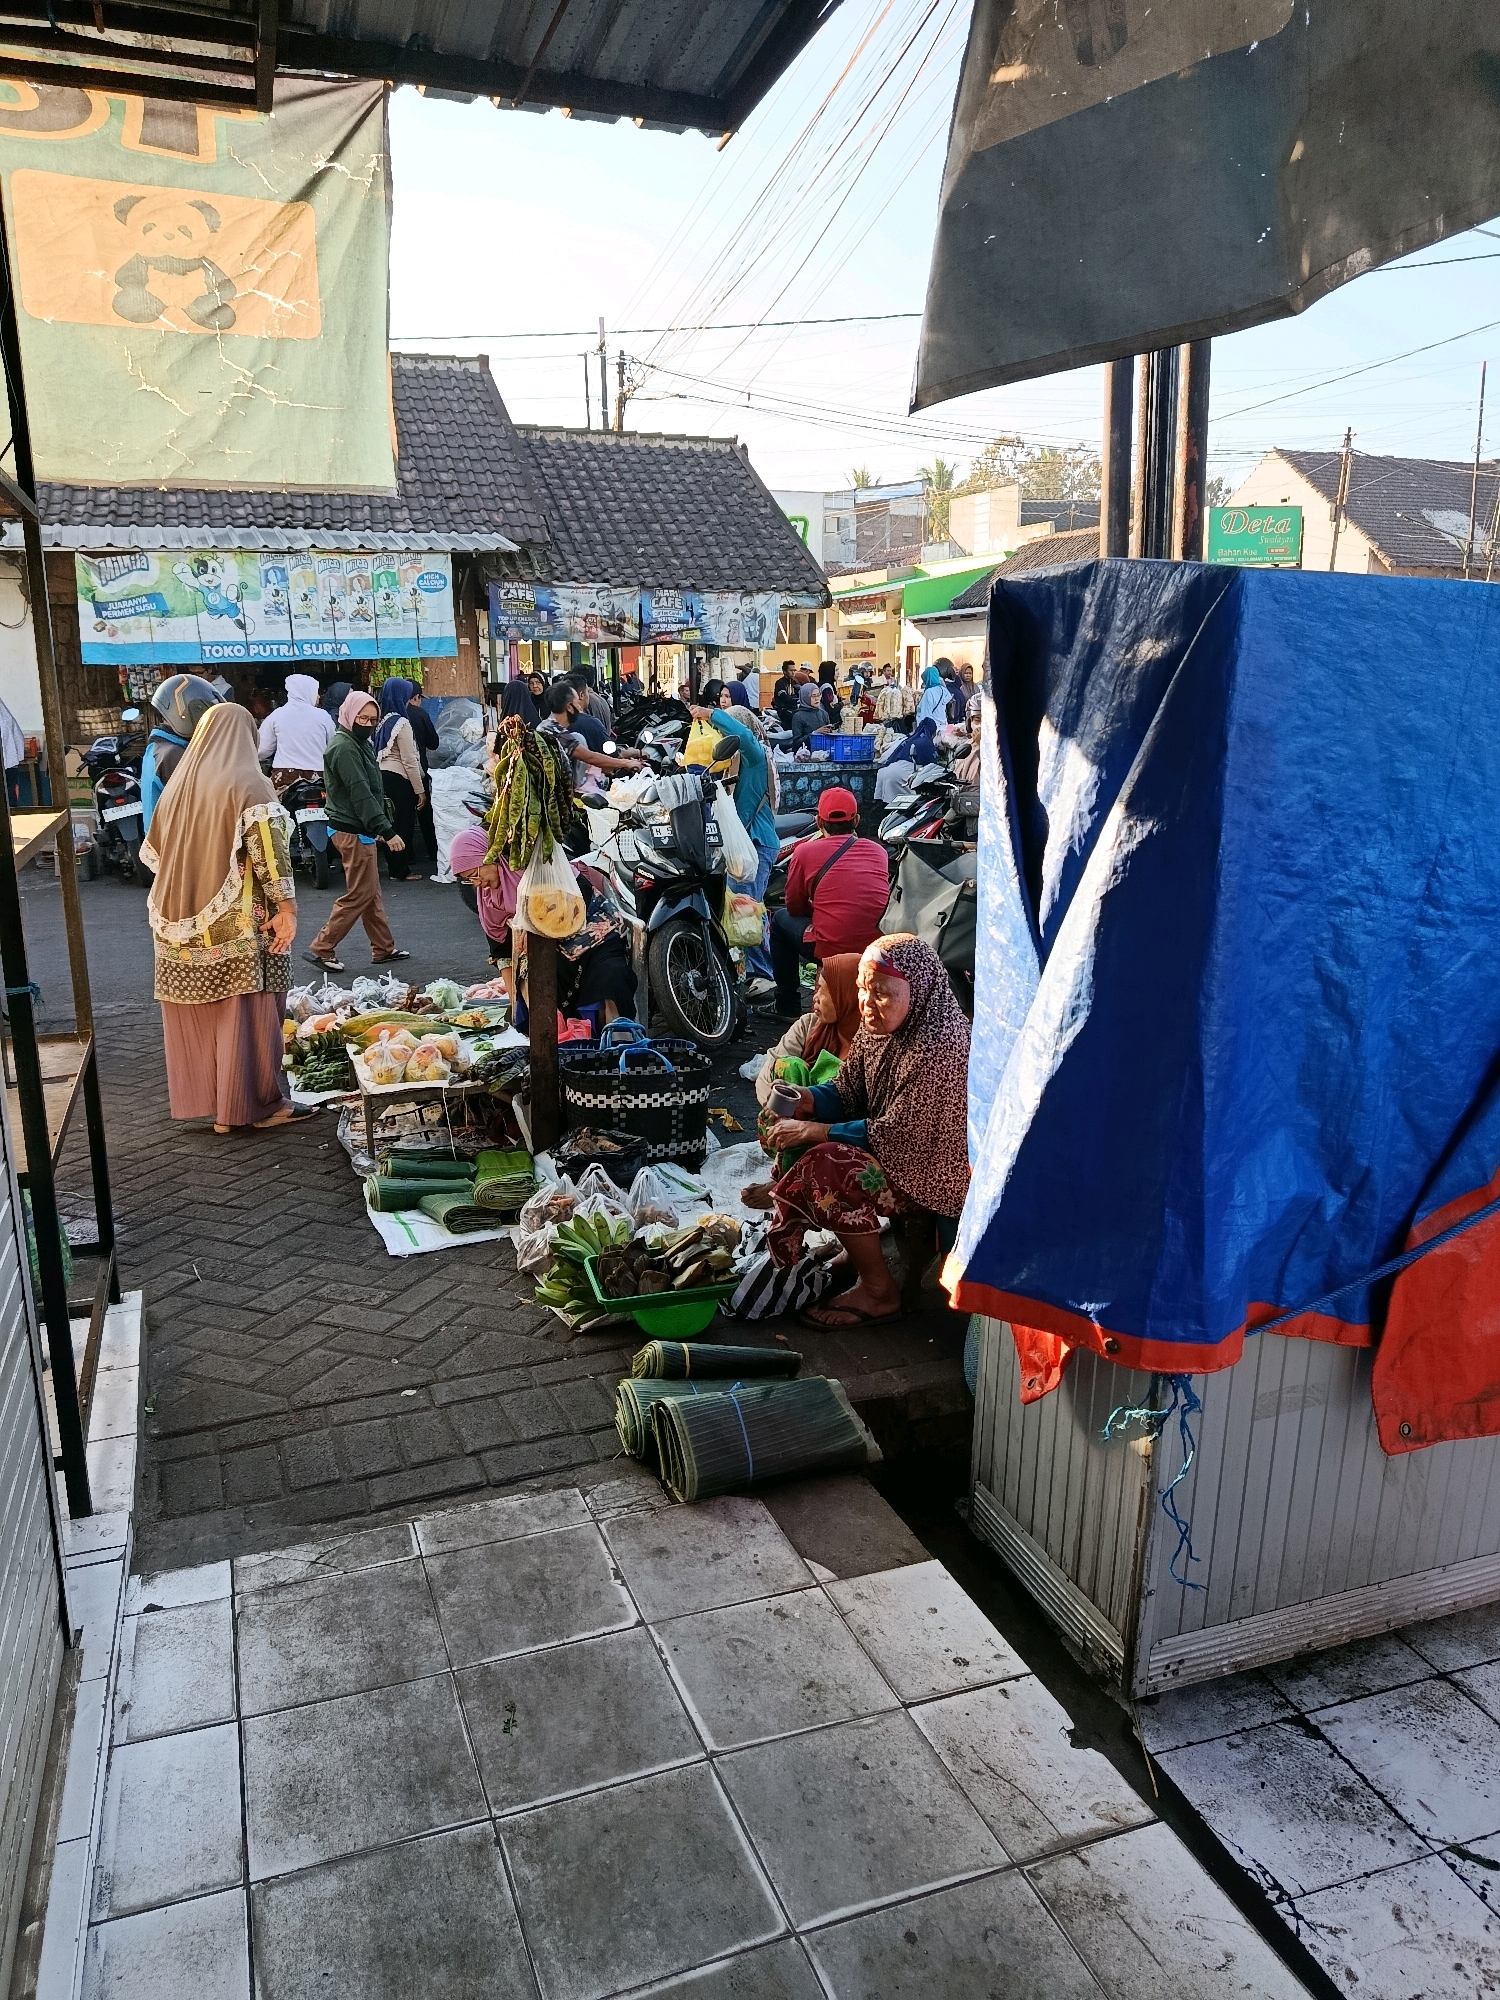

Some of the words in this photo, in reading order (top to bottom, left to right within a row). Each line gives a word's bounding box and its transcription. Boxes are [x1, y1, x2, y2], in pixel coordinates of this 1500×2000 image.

[1221, 510, 1291, 535] Deta
[1218, 548, 1241, 557] Bahan
[499, 588, 535, 602] CAFE
[651, 596, 683, 609] CAFE
[101, 607, 136, 620] PERMEN
[136, 602, 157, 614] SUSU
[107, 596, 148, 611] JUARANYA
[202, 644, 246, 658] TOKO
[248, 643, 300, 657] PUTRA
[303, 642, 351, 656] SURYA
